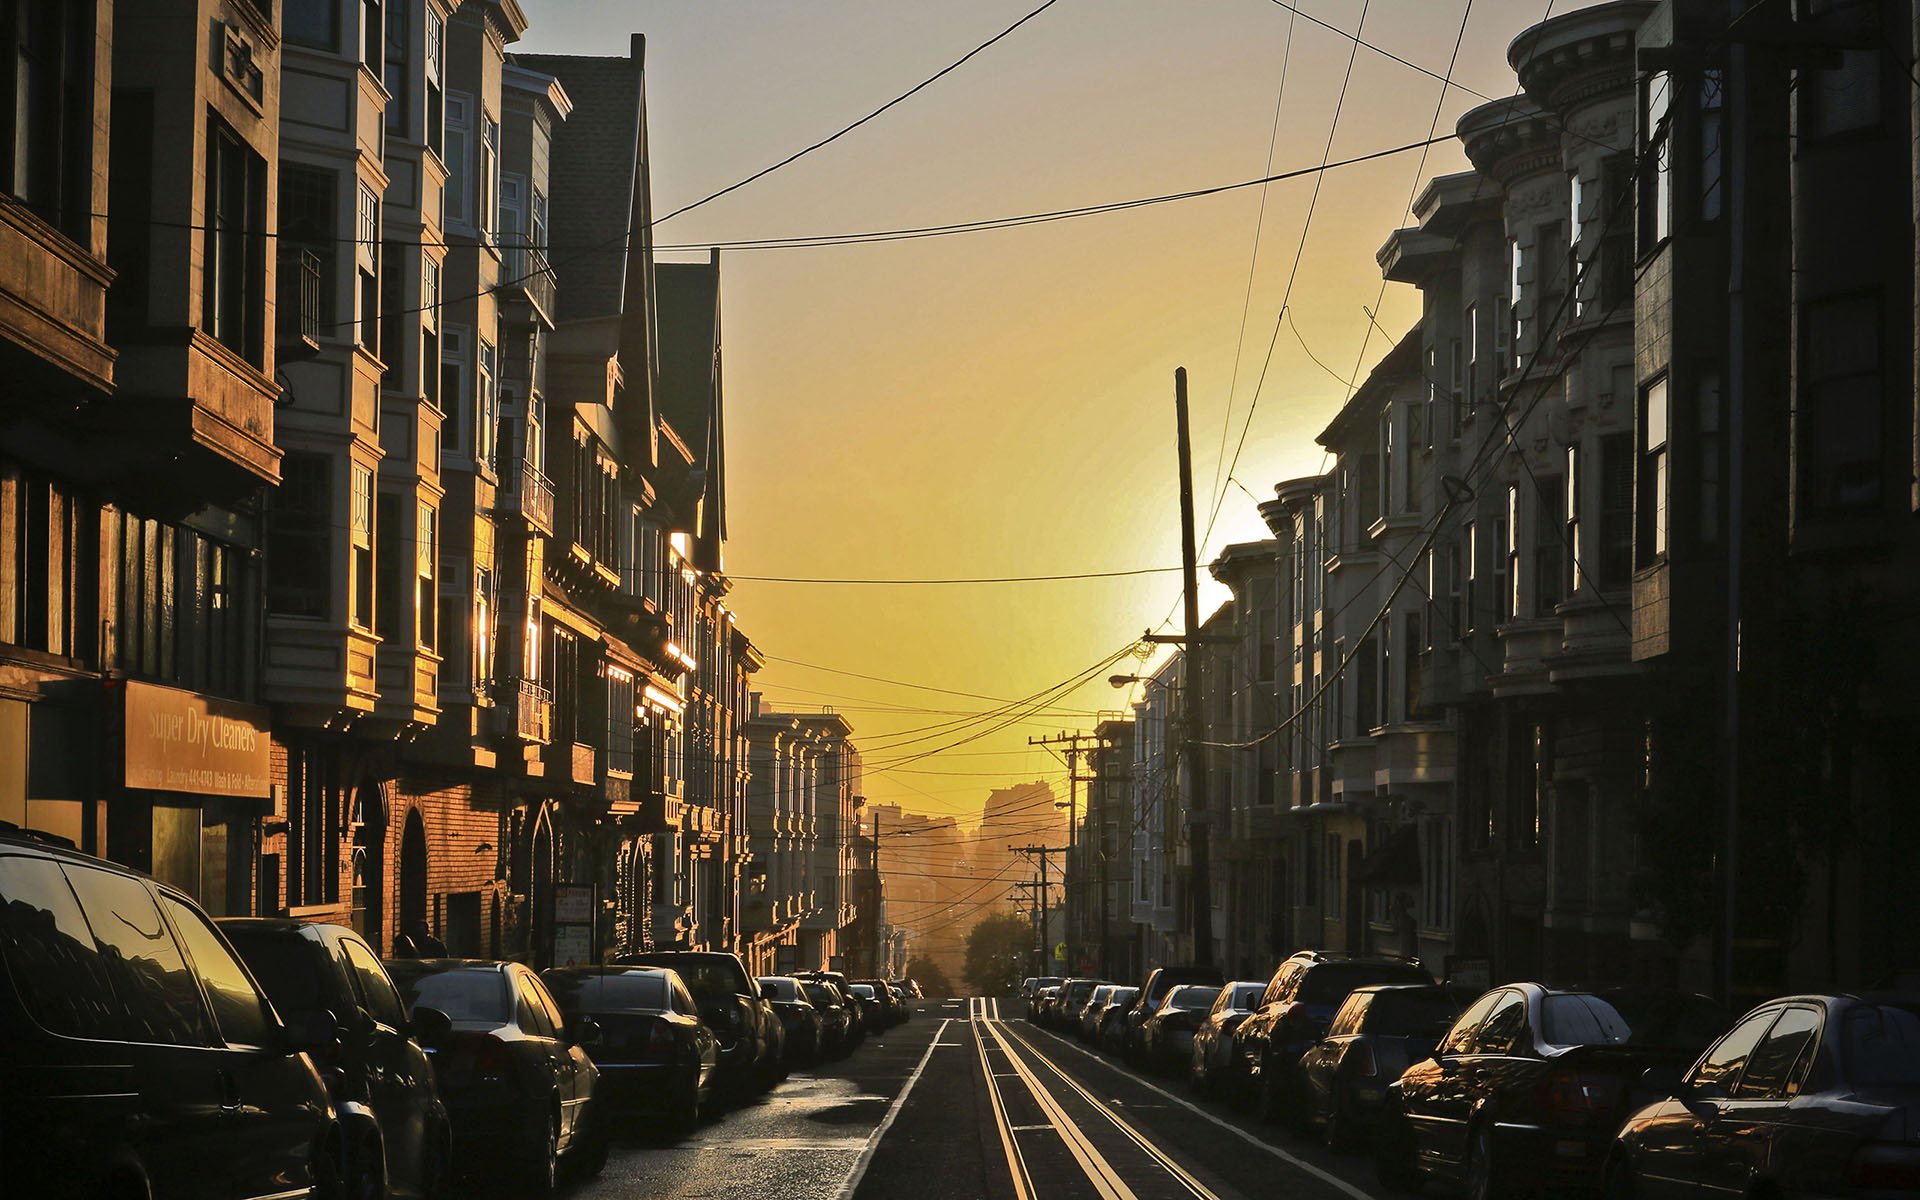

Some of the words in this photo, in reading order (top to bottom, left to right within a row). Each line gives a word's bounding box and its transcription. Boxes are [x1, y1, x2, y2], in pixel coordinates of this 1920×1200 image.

[149, 711, 184, 753] Super
[187, 706, 209, 758] Dry
[211, 715, 256, 752] Cleaners
